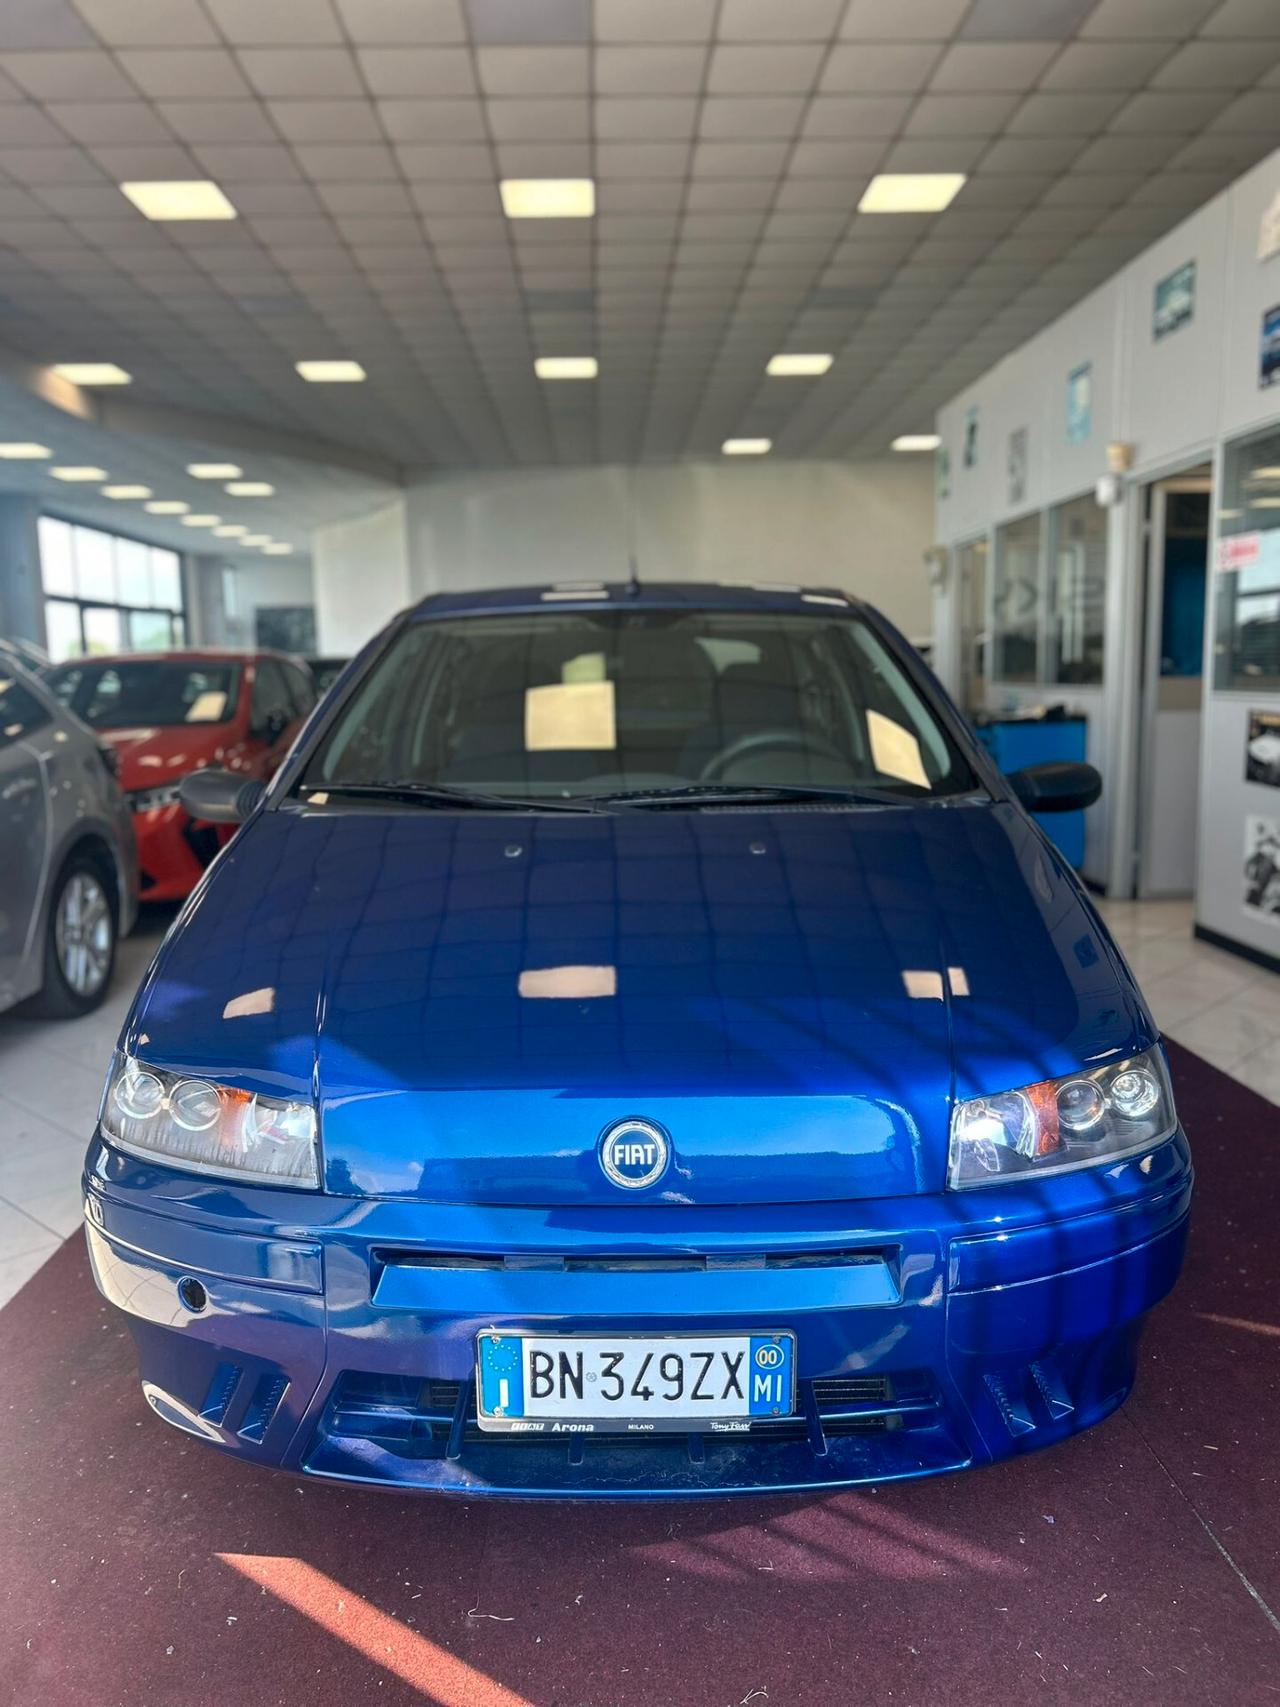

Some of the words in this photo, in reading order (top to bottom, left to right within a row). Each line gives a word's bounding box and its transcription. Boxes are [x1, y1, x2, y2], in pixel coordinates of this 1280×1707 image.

[614, 1144, 656, 1166] FIAT
[760, 1349, 778, 1366] 00
[529, 1351, 584, 1399] BN
[754, 1374, 783, 1403] MI
[551, 1422, 595, 1432] Arona
[627, 1423, 655, 1431] MILANO
